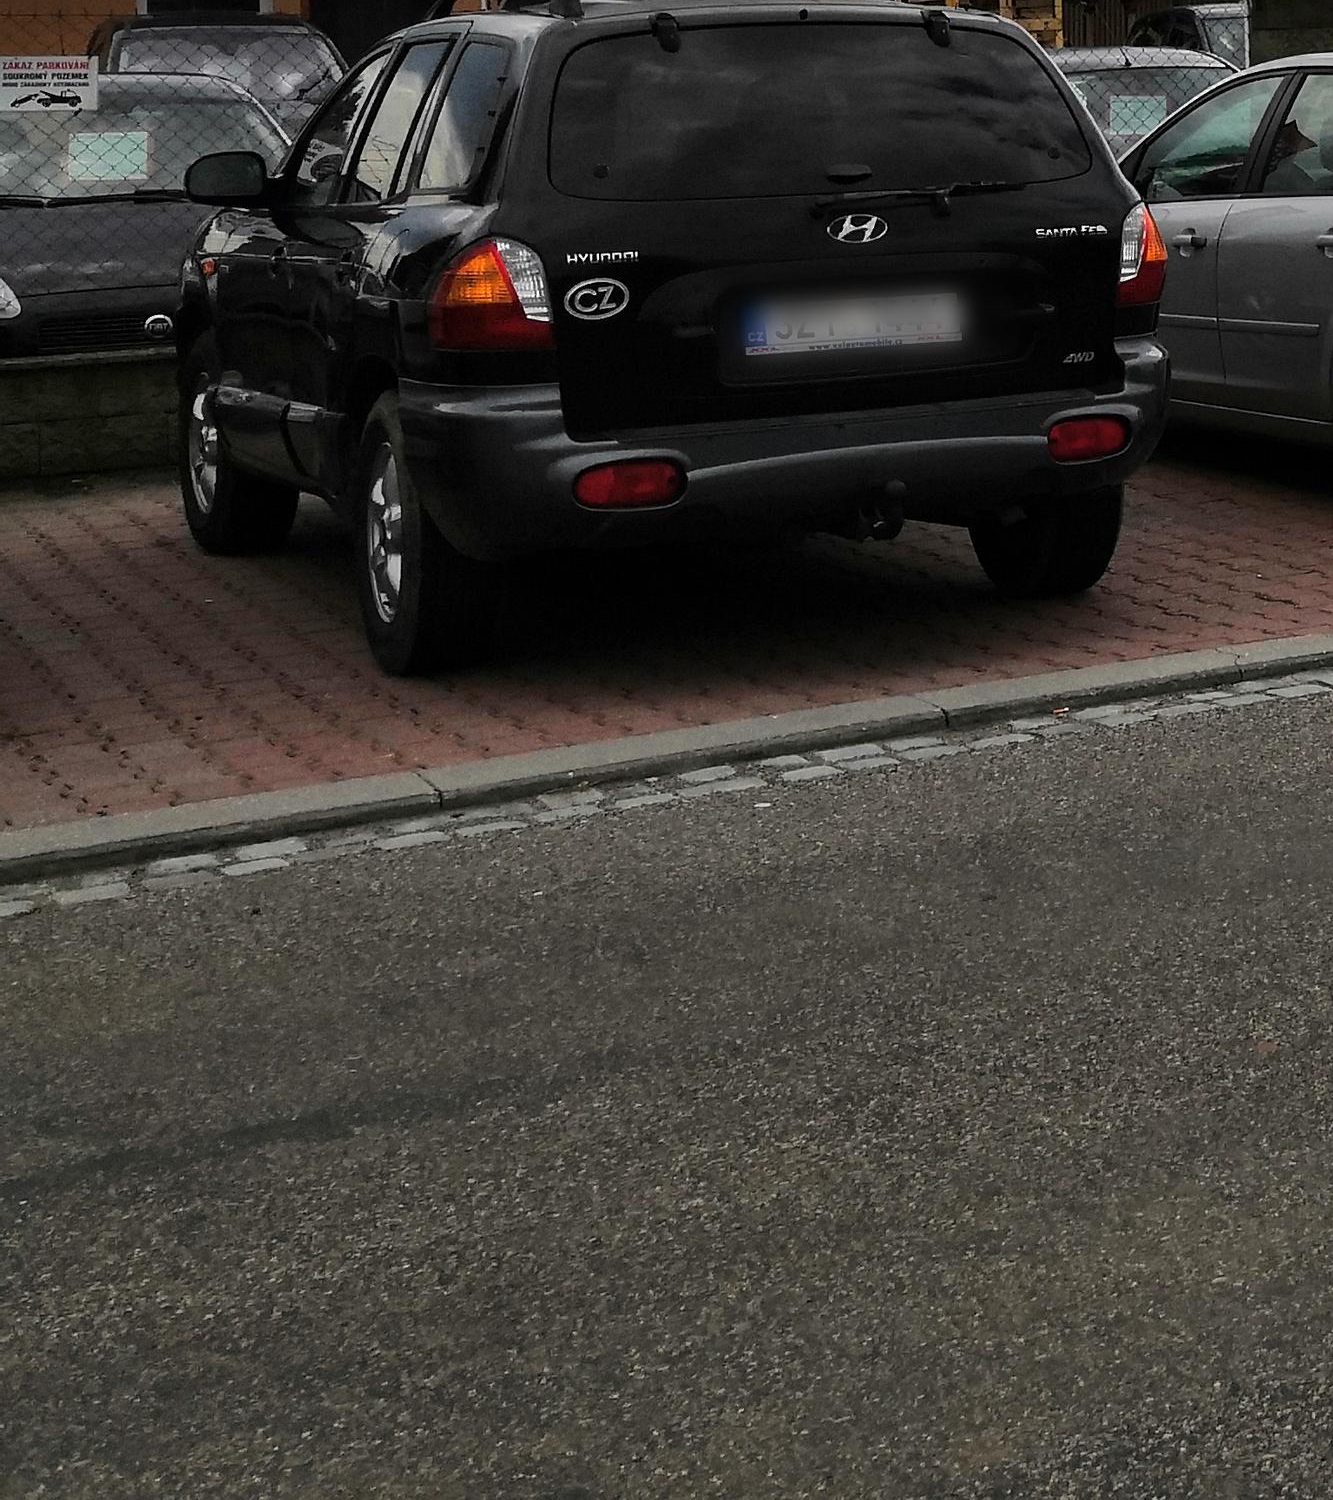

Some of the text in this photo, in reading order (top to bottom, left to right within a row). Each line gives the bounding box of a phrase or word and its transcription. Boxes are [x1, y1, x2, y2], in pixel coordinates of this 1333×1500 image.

[1035, 227, 1079, 239] SANTA
[566, 250, 639, 264] HYUNDAI
[574, 285, 617, 313] CZ
